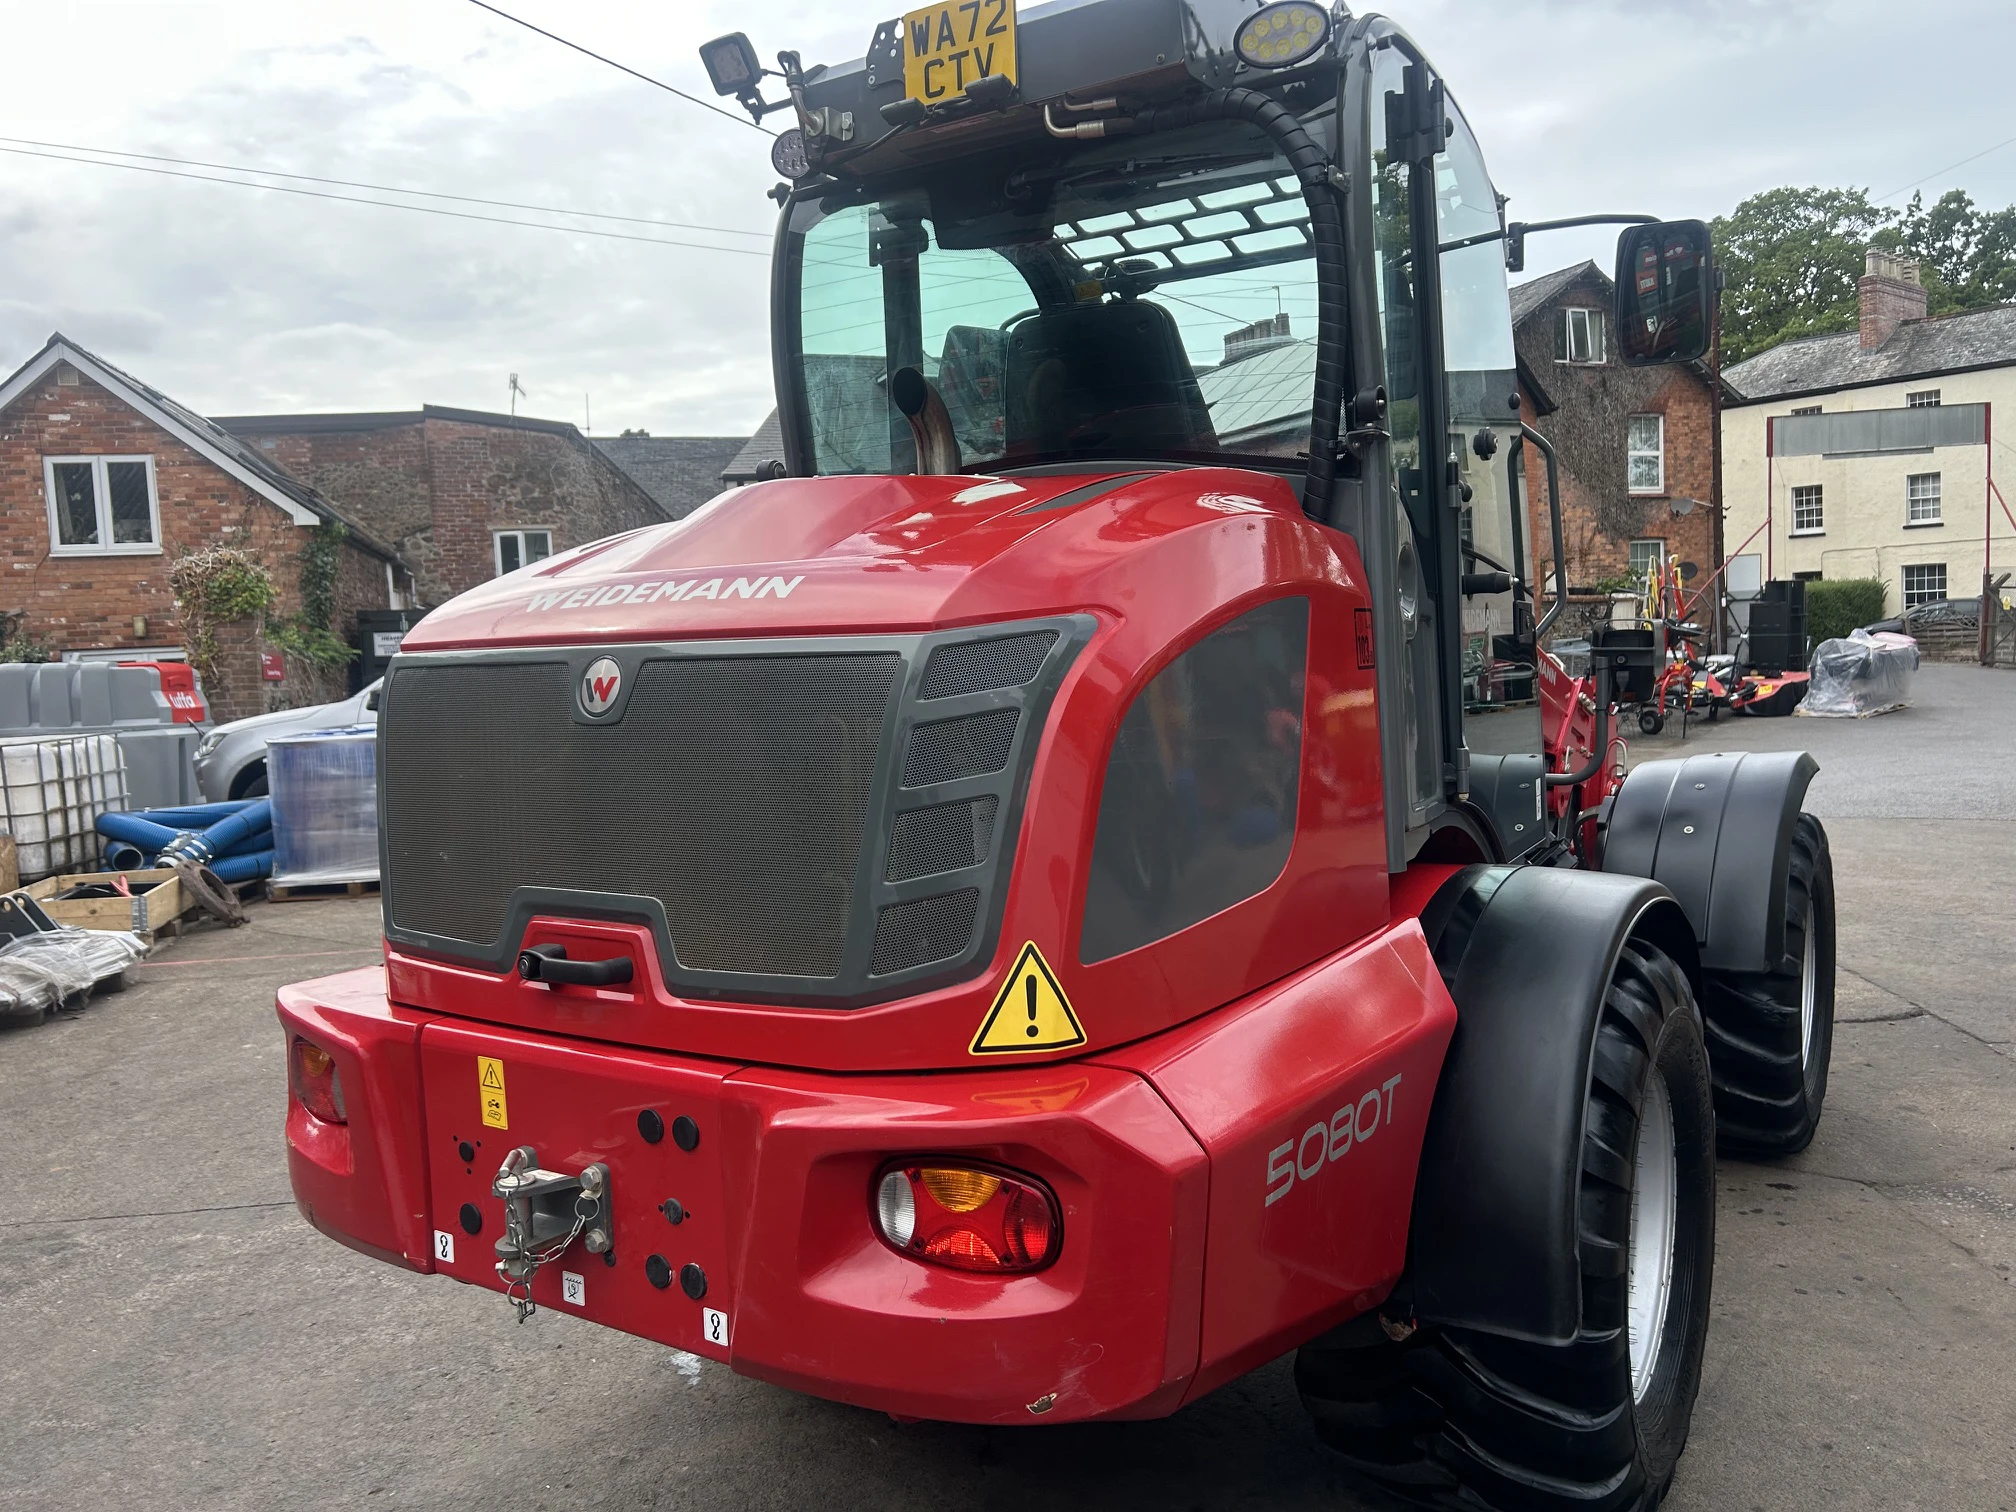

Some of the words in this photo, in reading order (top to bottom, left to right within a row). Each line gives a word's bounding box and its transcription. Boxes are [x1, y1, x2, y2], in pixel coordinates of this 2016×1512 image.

[910, 0, 1007, 57] WA72
[924, 42, 994, 98] CTV
[525, 575, 806, 613] WEIDEMANN
[1264, 1072, 1402, 1208] 5080T
